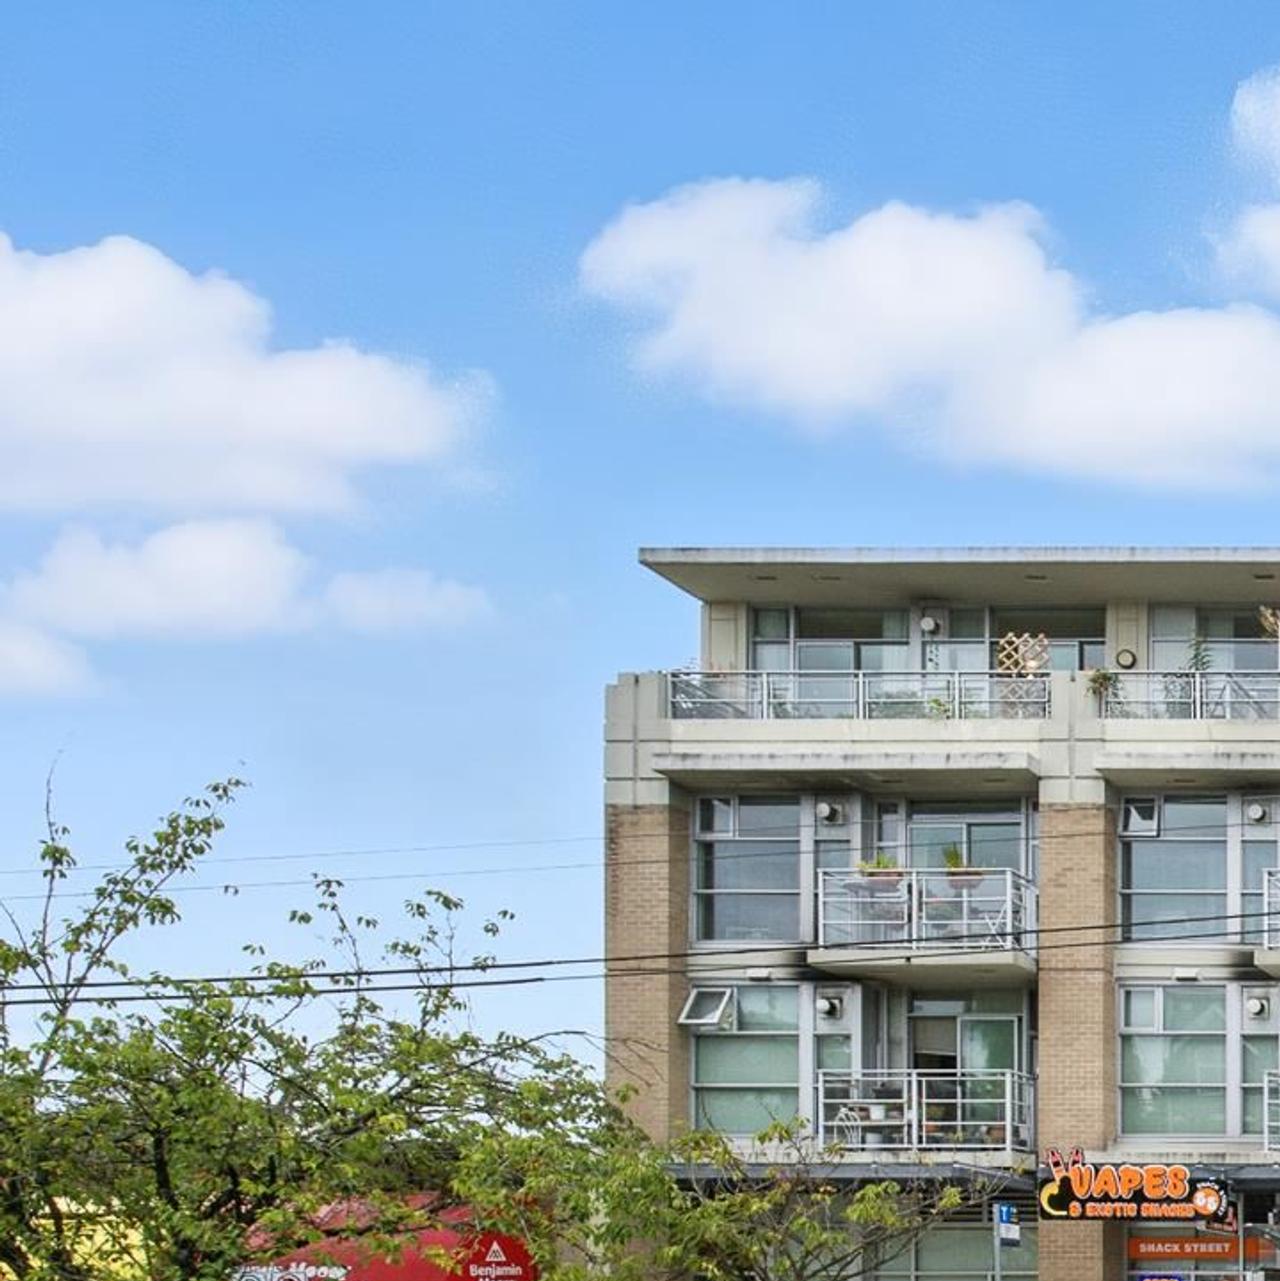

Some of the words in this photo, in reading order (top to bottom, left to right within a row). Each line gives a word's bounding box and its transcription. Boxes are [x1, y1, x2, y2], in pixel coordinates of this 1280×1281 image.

[1069, 1163, 1190, 1199] VAPES
[1139, 1242, 1181, 1253] SNACK
[1184, 1242, 1231, 1253] STREET
[469, 1263, 523, 1278] Benjamin
